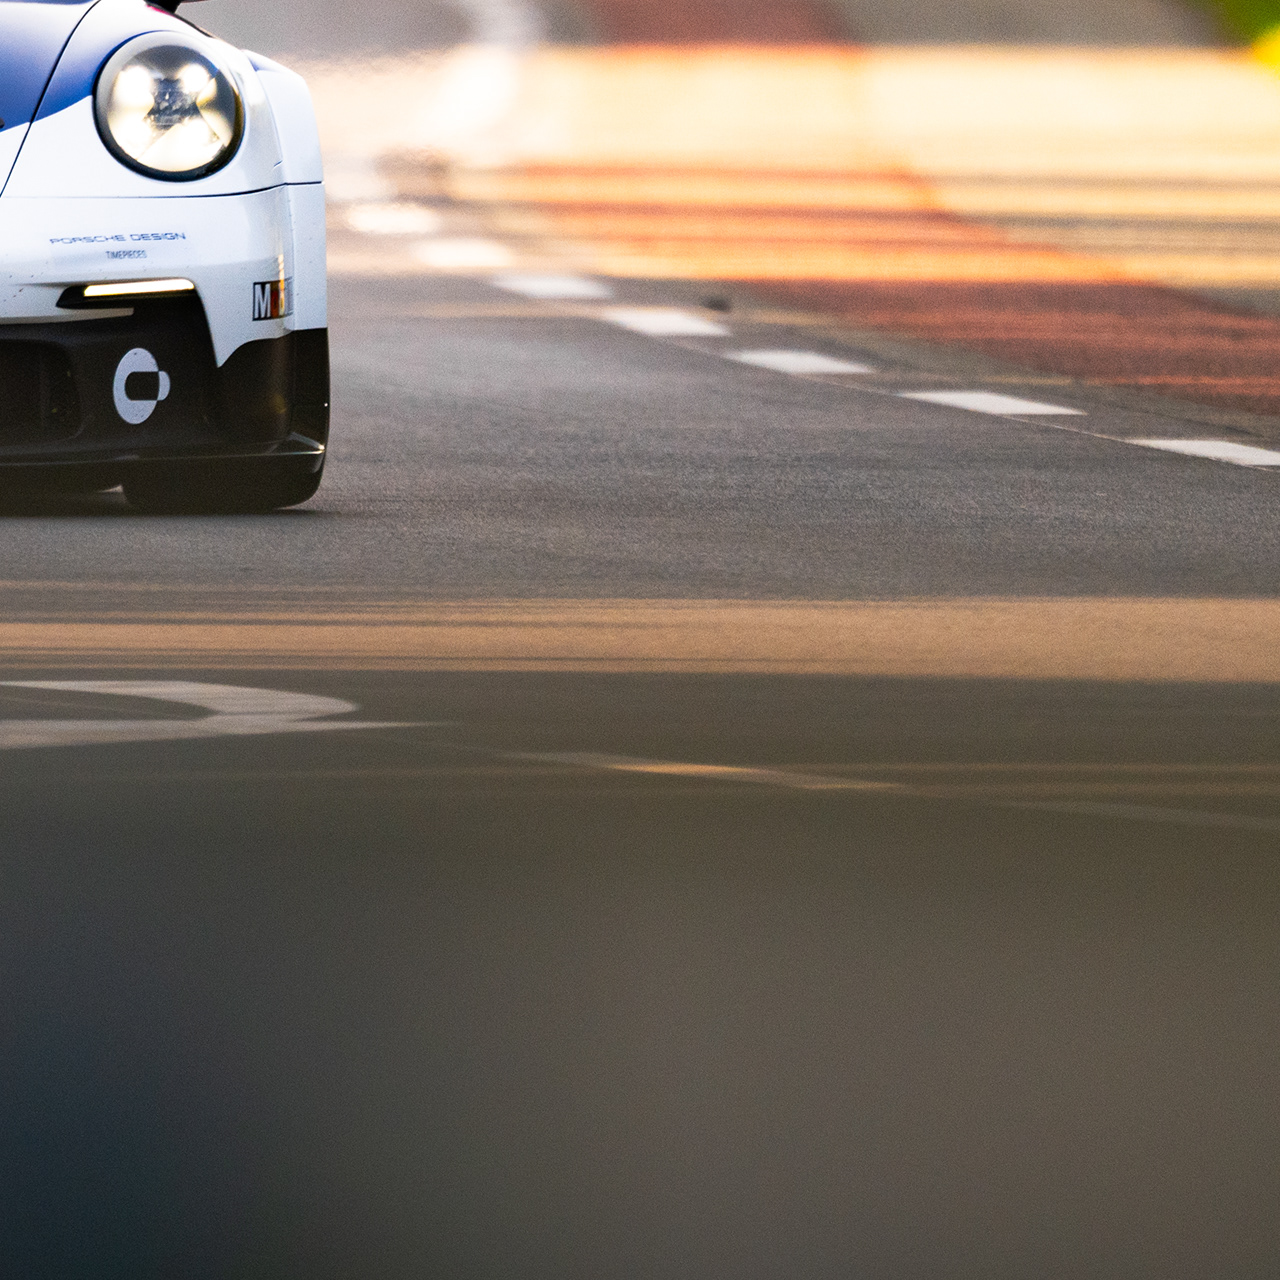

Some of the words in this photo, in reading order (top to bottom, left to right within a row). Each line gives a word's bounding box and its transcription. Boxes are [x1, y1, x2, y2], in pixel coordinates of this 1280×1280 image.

[49, 234, 126, 245] PORSCHE
[130, 232, 186, 241] DESIGN
[106, 250, 147, 259] TIMEPIECES
